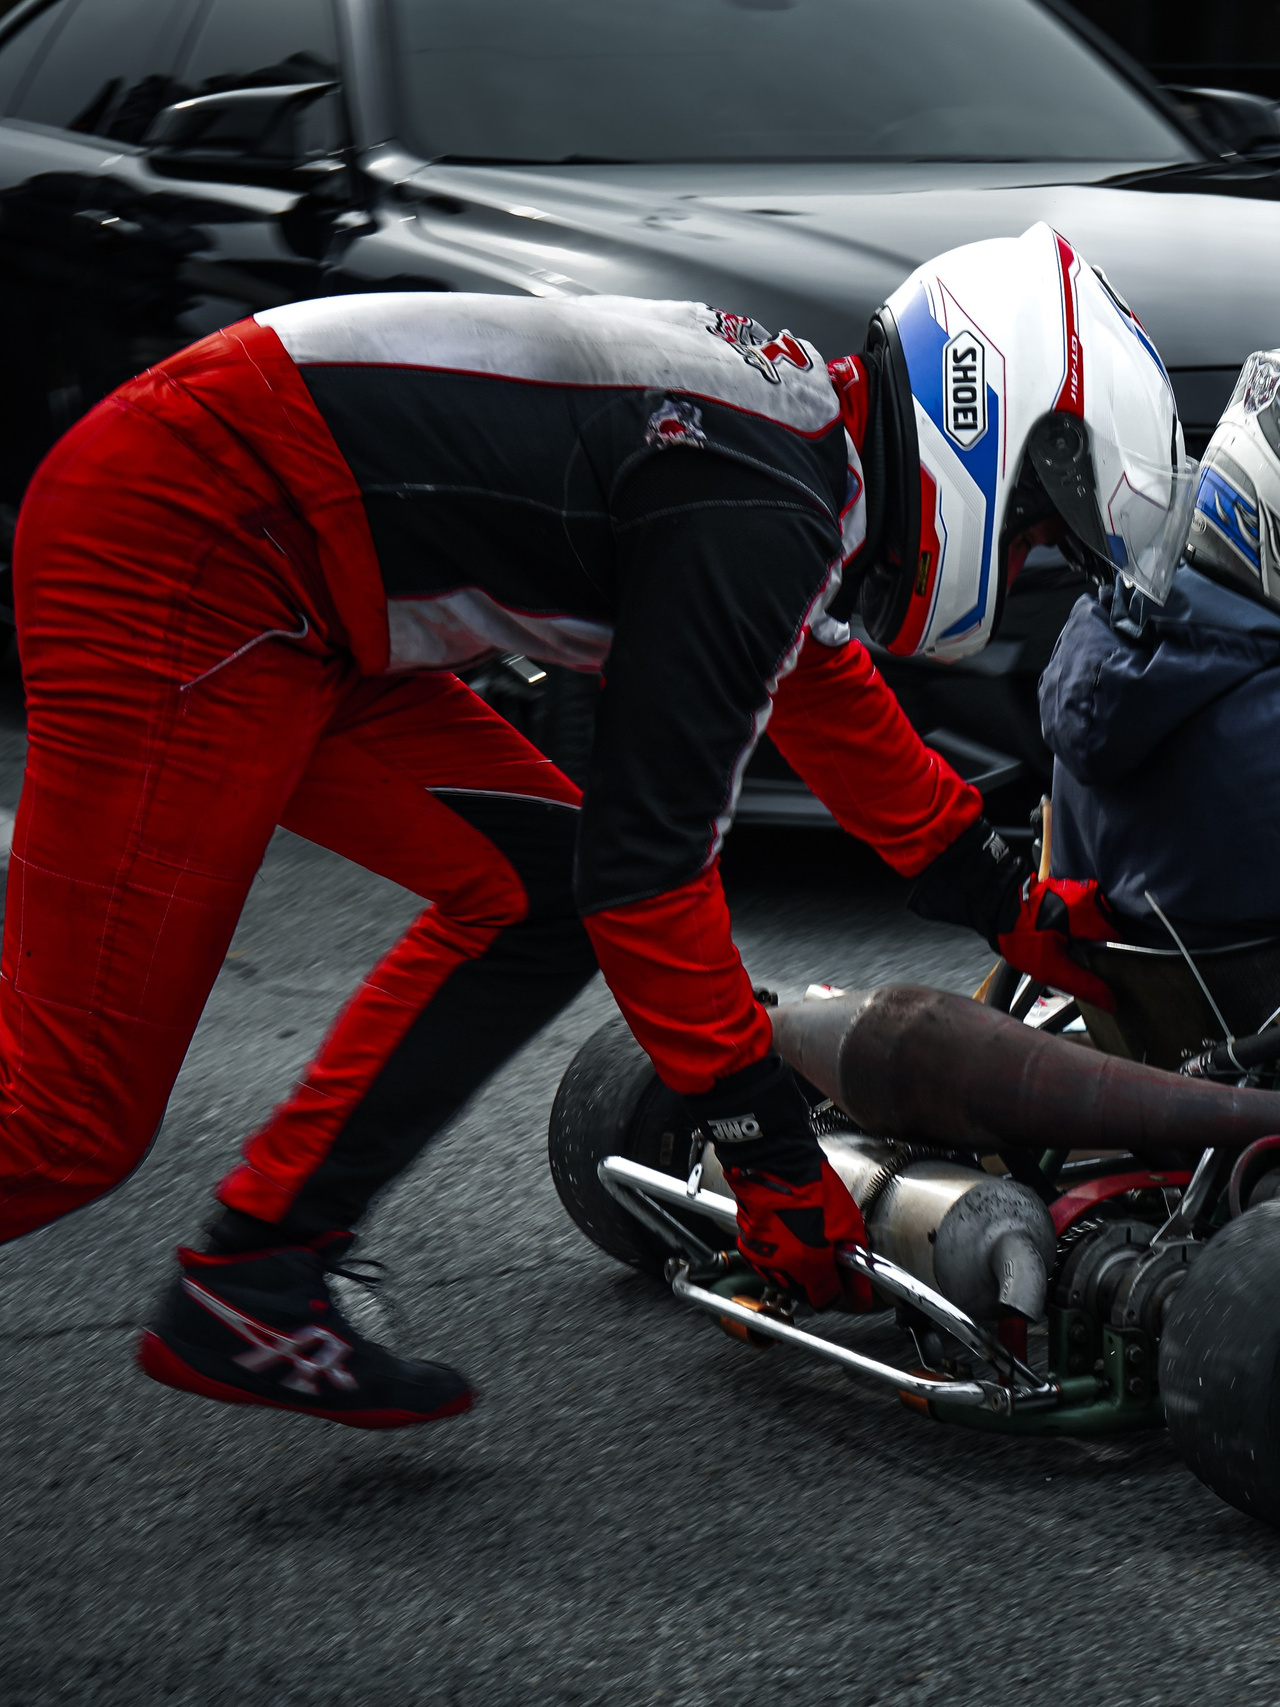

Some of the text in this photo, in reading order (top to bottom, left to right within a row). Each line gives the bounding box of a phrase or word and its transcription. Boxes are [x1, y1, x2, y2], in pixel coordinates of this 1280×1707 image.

[952, 346, 978, 431] SHOEI
[1071, 334, 1079, 405] GT-Air
[712, 1117, 760, 1140] OMP
